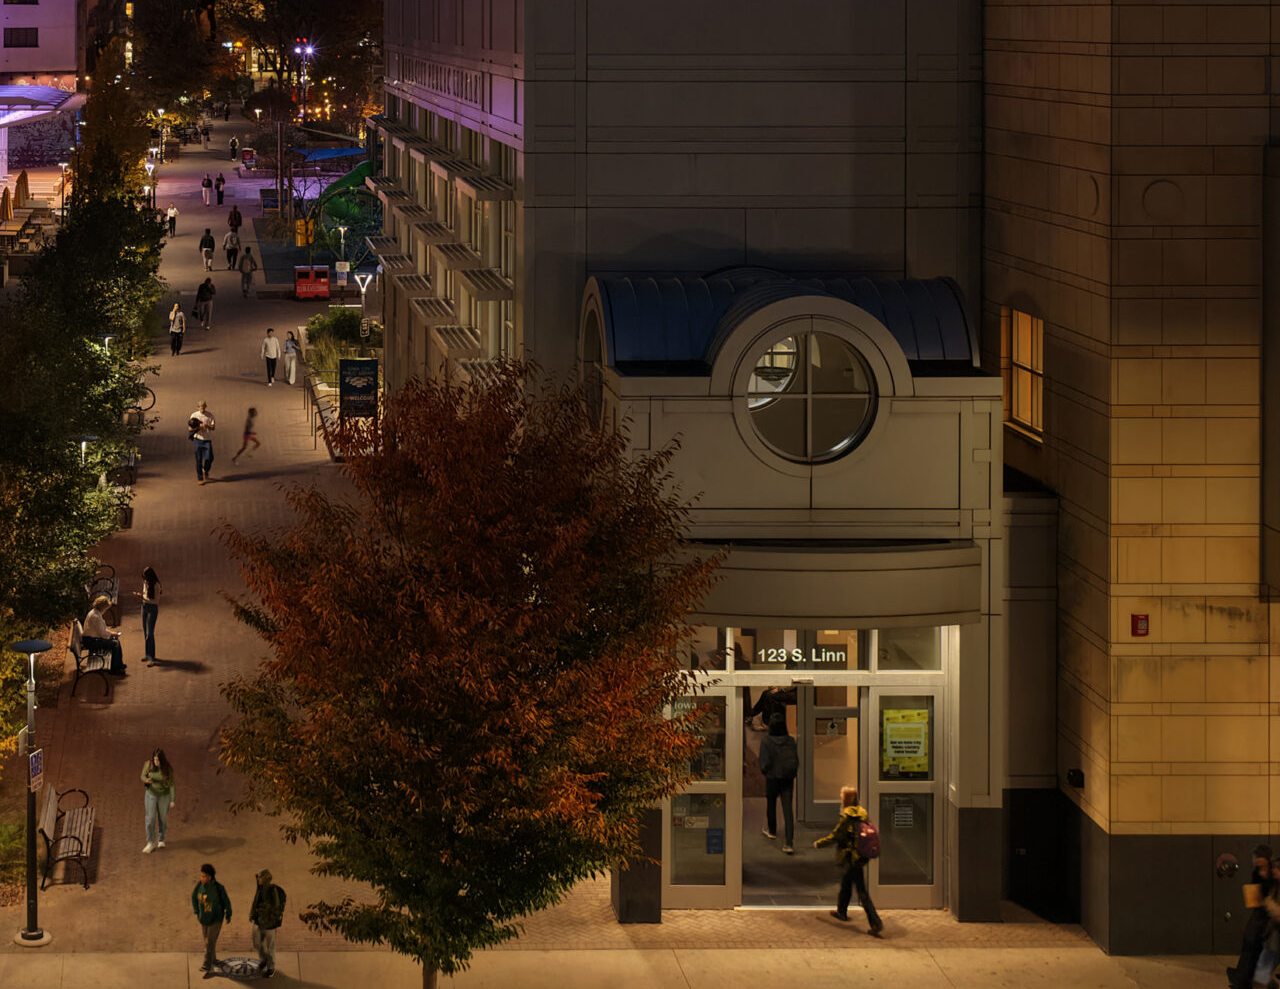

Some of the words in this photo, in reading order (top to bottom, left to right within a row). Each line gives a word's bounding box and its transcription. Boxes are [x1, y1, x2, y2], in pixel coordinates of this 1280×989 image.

[757, 648, 787, 662] 123
[791, 648, 807, 662] S.
[811, 647, 846, 662] Linn
[674, 702, 697, 710] Iowa
